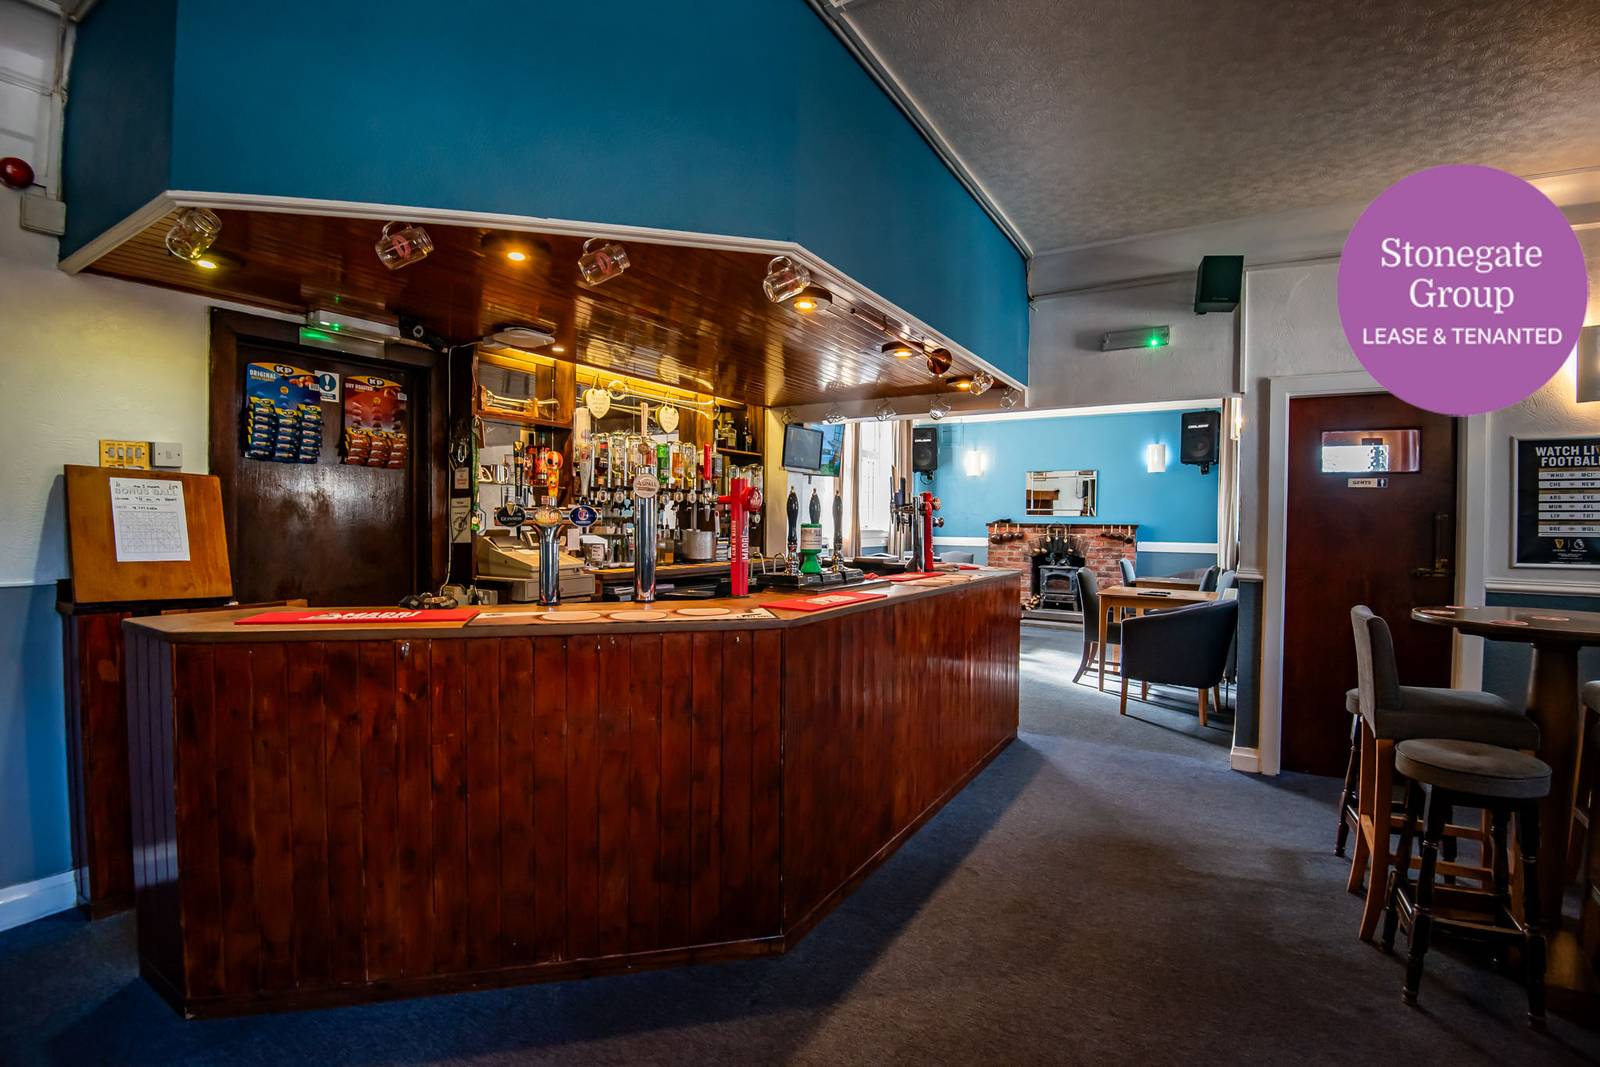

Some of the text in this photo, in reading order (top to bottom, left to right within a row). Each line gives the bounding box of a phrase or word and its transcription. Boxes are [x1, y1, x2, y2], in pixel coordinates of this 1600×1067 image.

[249, 368, 277, 380] ORIGINAL
[276, 365, 293, 374] KP
[1535, 446, 1579, 456] WATCH
[1541, 456, 1600, 467] FOOTBAL
